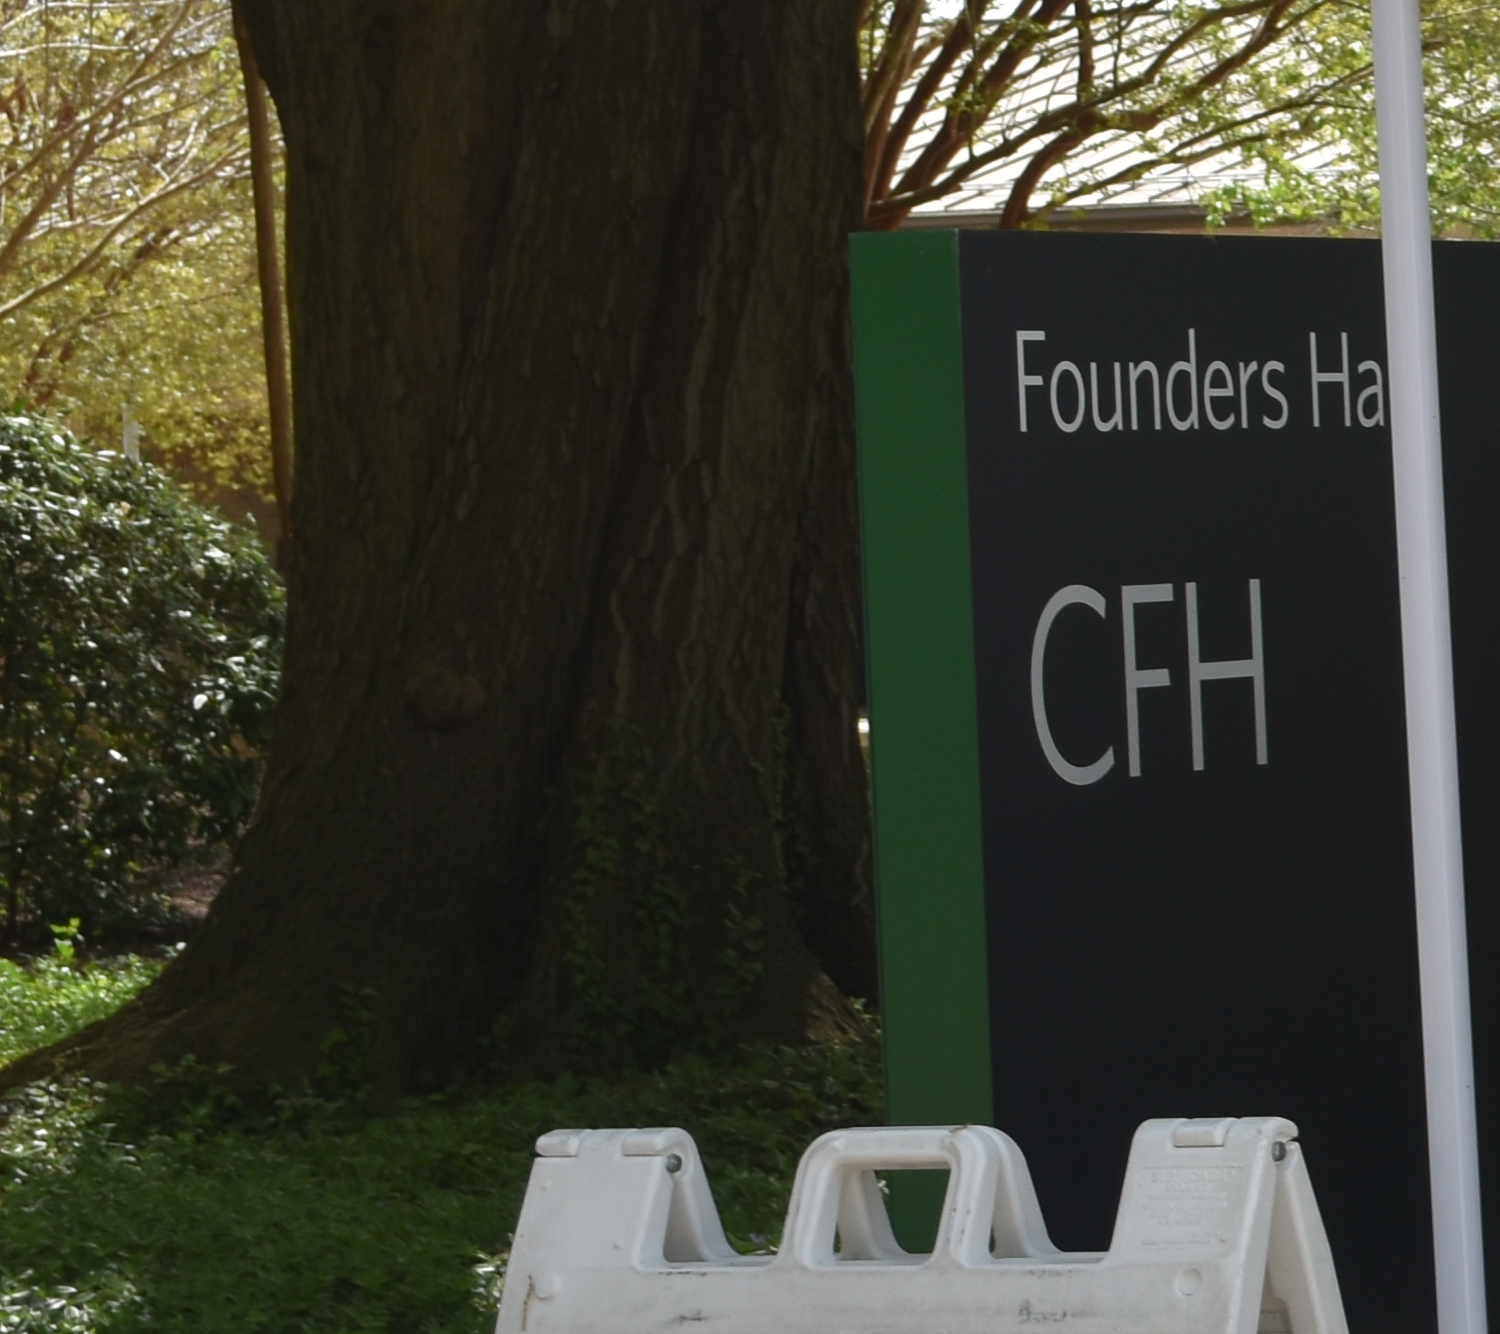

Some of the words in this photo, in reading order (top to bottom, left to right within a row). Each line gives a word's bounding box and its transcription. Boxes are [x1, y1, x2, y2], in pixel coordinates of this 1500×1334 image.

[1015, 327, 1289, 433] Founders
[1308, 331, 1386, 427] Ha
[1030, 578, 1268, 786] CFH
